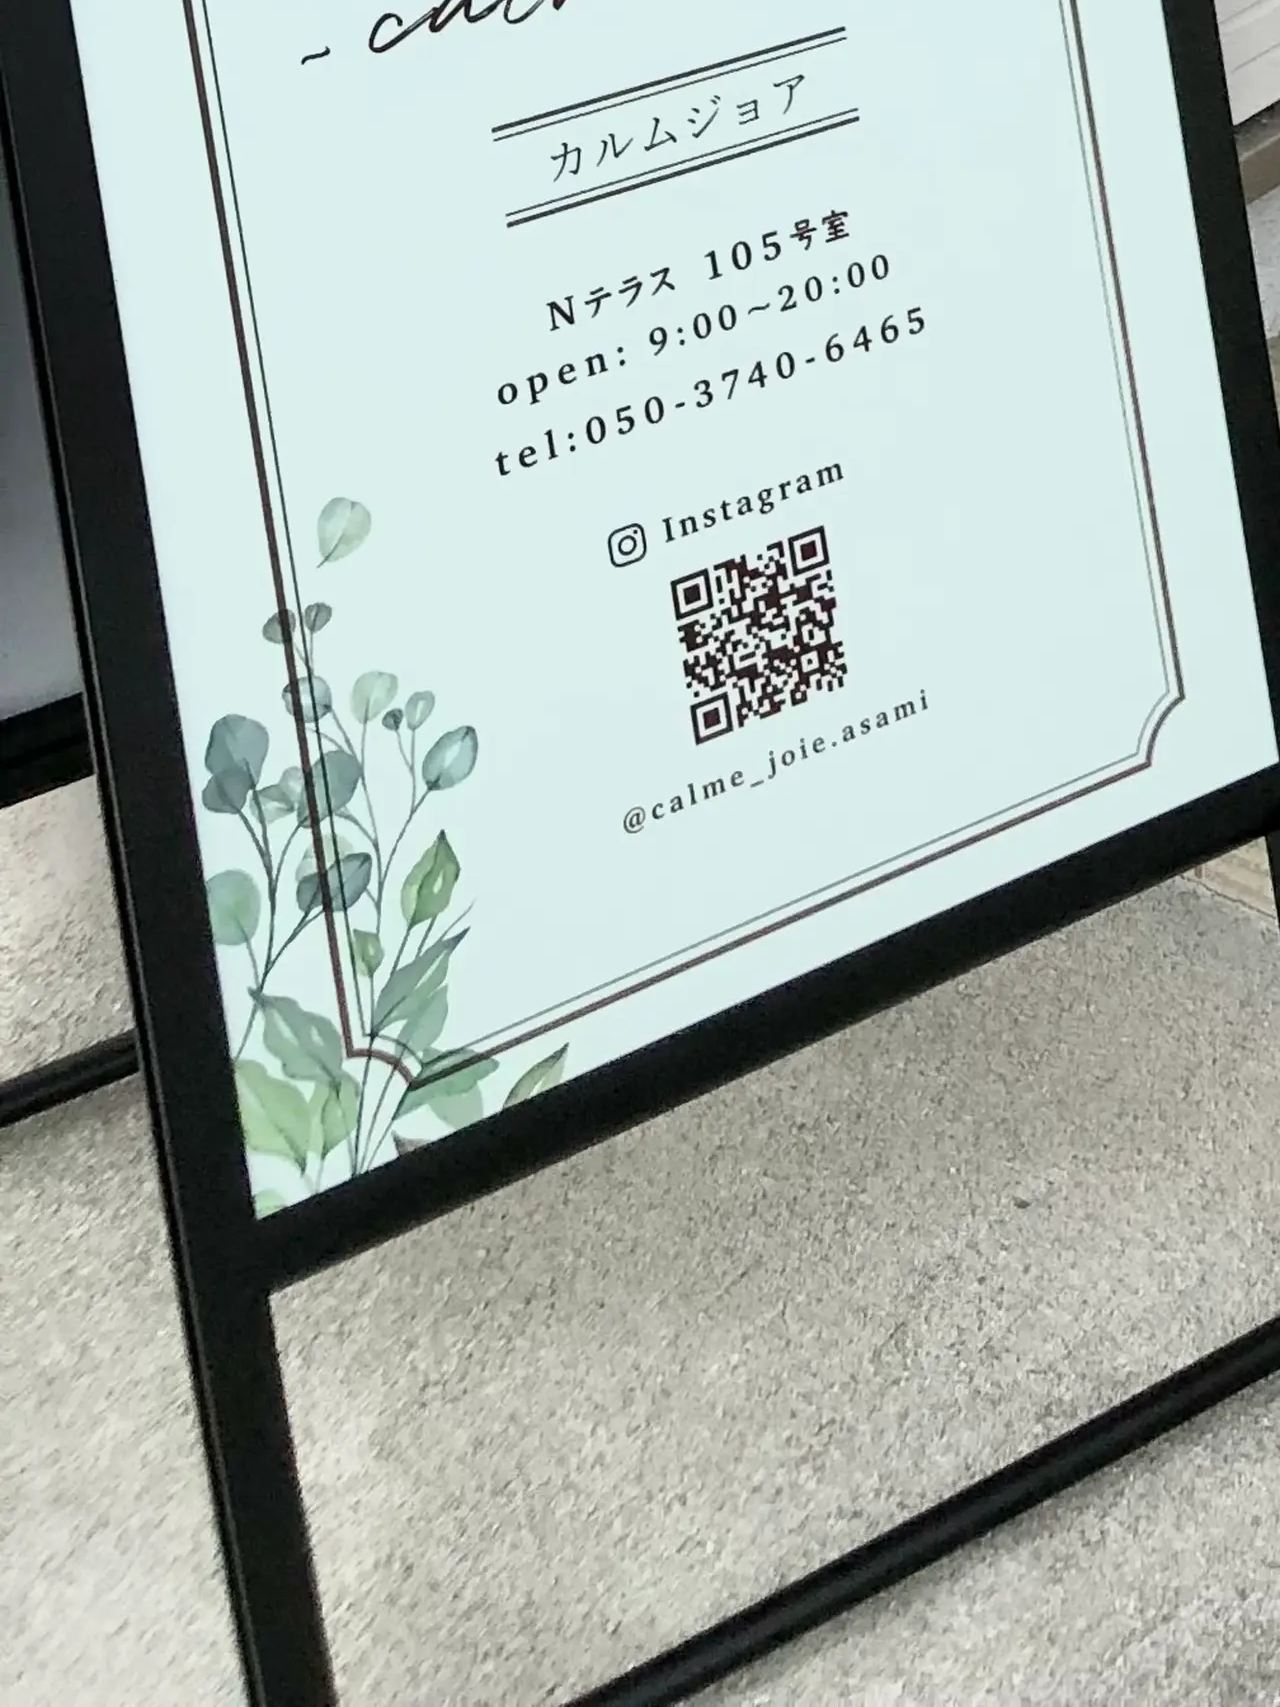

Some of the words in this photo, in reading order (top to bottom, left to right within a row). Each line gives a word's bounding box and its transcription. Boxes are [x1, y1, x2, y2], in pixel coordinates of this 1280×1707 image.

[549, 73, 806, 184] カルムジョア
[544, 265, 677, 333] Nテラス
[703, 208, 851, 282] 105号室
[493, 305, 926, 477] tel:050-3740-6465
[496, 345, 627, 406] open:
[660, 462, 845, 544] Instagram
[621, 687, 930, 835] @calme_joie.asami
